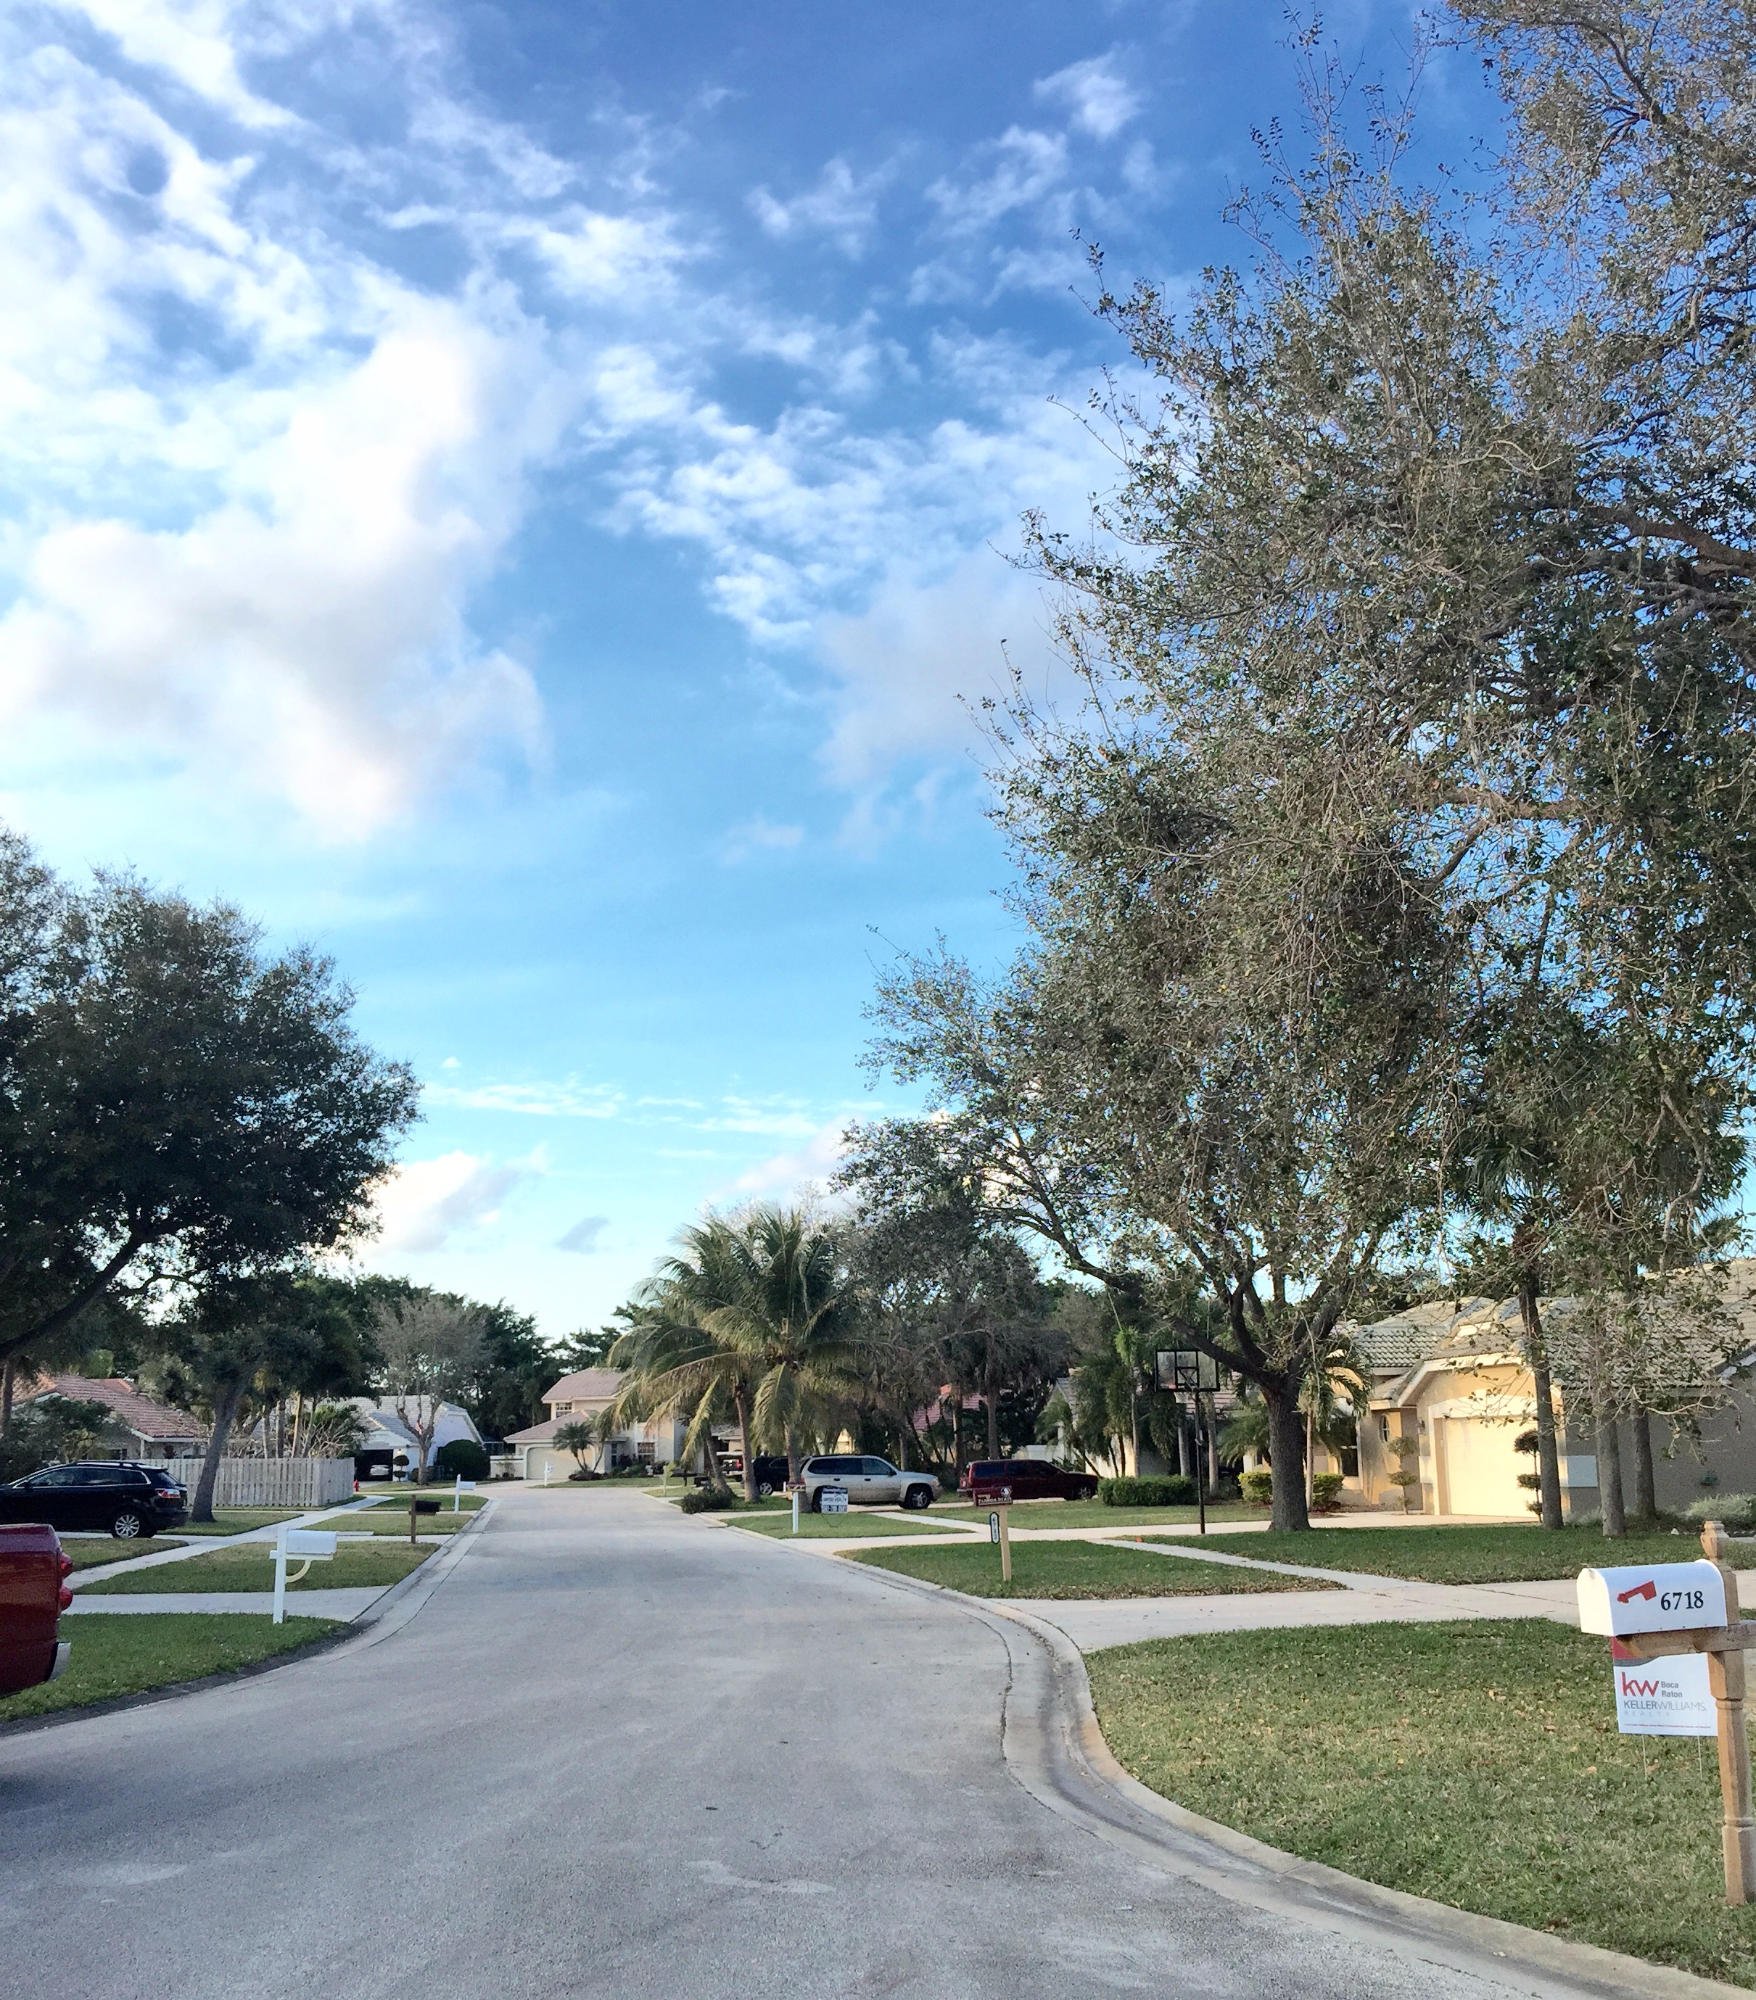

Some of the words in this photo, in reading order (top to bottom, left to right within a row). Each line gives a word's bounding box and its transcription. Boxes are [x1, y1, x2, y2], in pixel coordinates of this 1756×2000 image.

[1660, 1590, 1704, 1611] 6718
[1660, 1681, 1679, 1689] Boca
[1661, 1690, 1683, 1698] Raton
